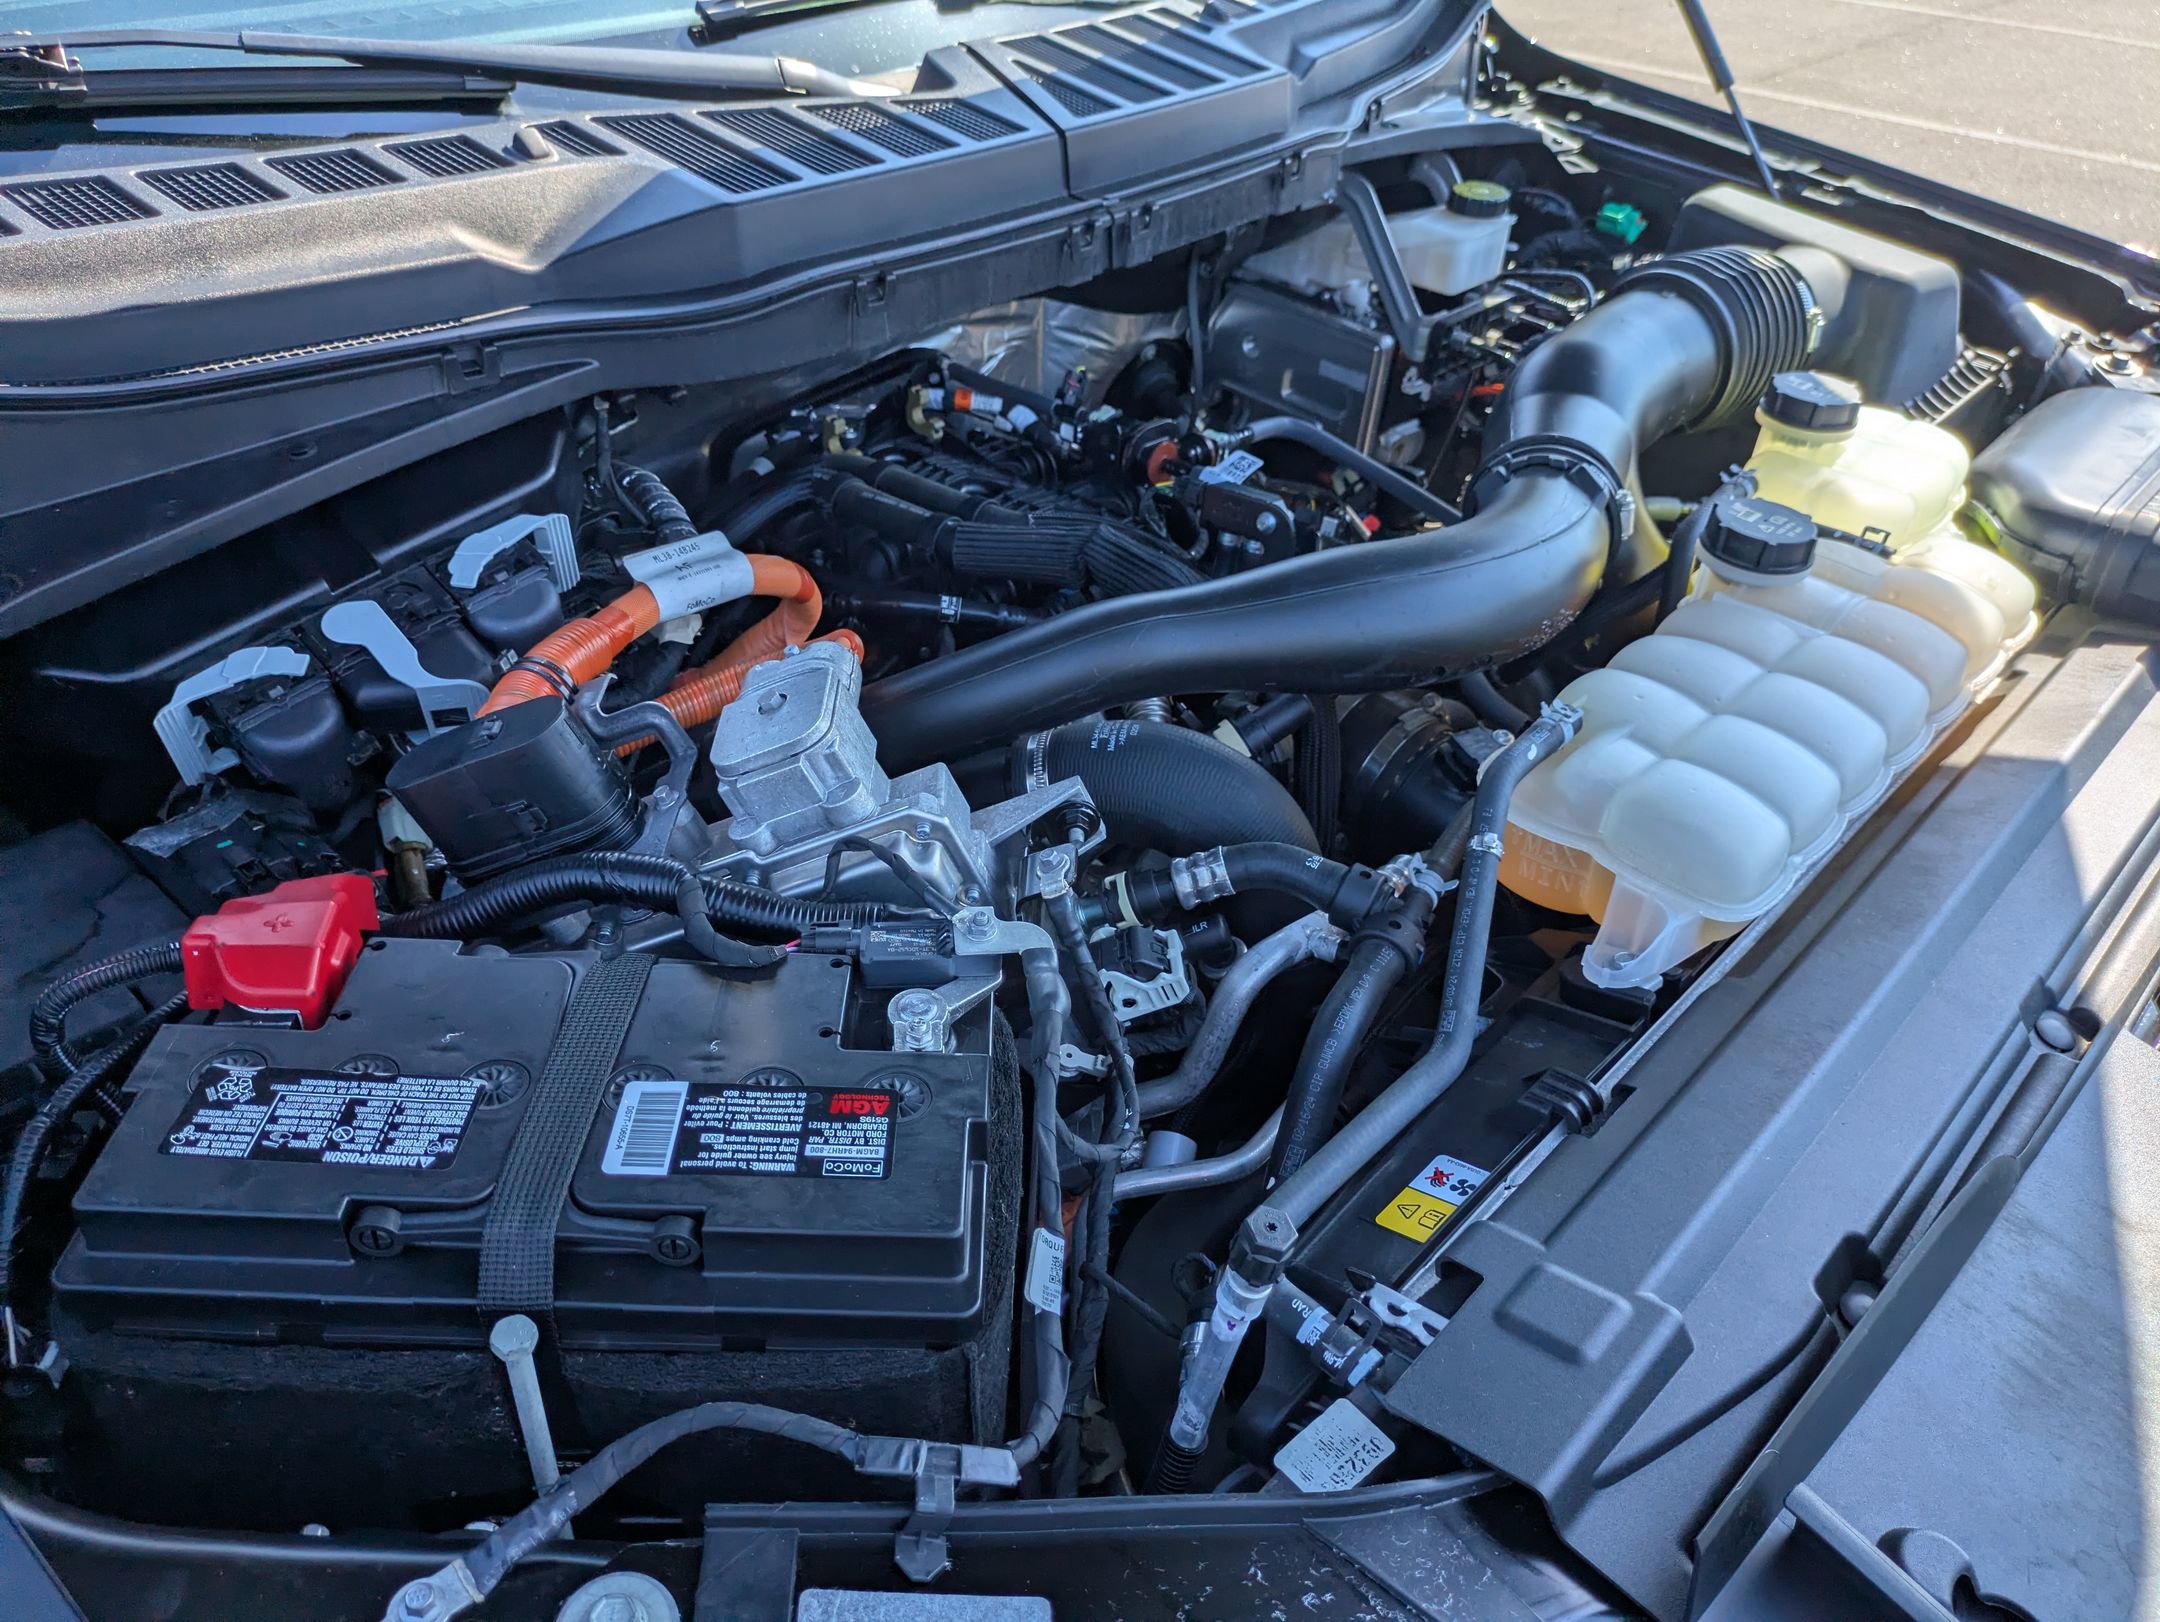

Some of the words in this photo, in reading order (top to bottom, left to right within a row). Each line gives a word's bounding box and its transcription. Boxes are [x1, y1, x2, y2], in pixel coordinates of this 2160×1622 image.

[1519, 857, 1571, 893] MIN
[755, 1097, 795, 1105] demarrage
[829, 1099, 889, 1115] AGM
[730, 1121, 801, 1130] AVERTISSEMENT
[842, 1121, 888, 1129] DEARBORN,
[747, 1135, 780, 1143] cranking
[321, 1151, 419, 1165] DANGER/POISON
[710, 1150, 732, 1158] guide
[774, 1152, 796, 1160] injury
[679, 1158, 714, 1168] personal
[748, 1161, 795, 1171] WARNING:
[824, 1162, 880, 1172] FoMoCo
[1039, 1232, 1064, 1254] TORQUE
[1291, 1298, 1312, 1318] RAD
